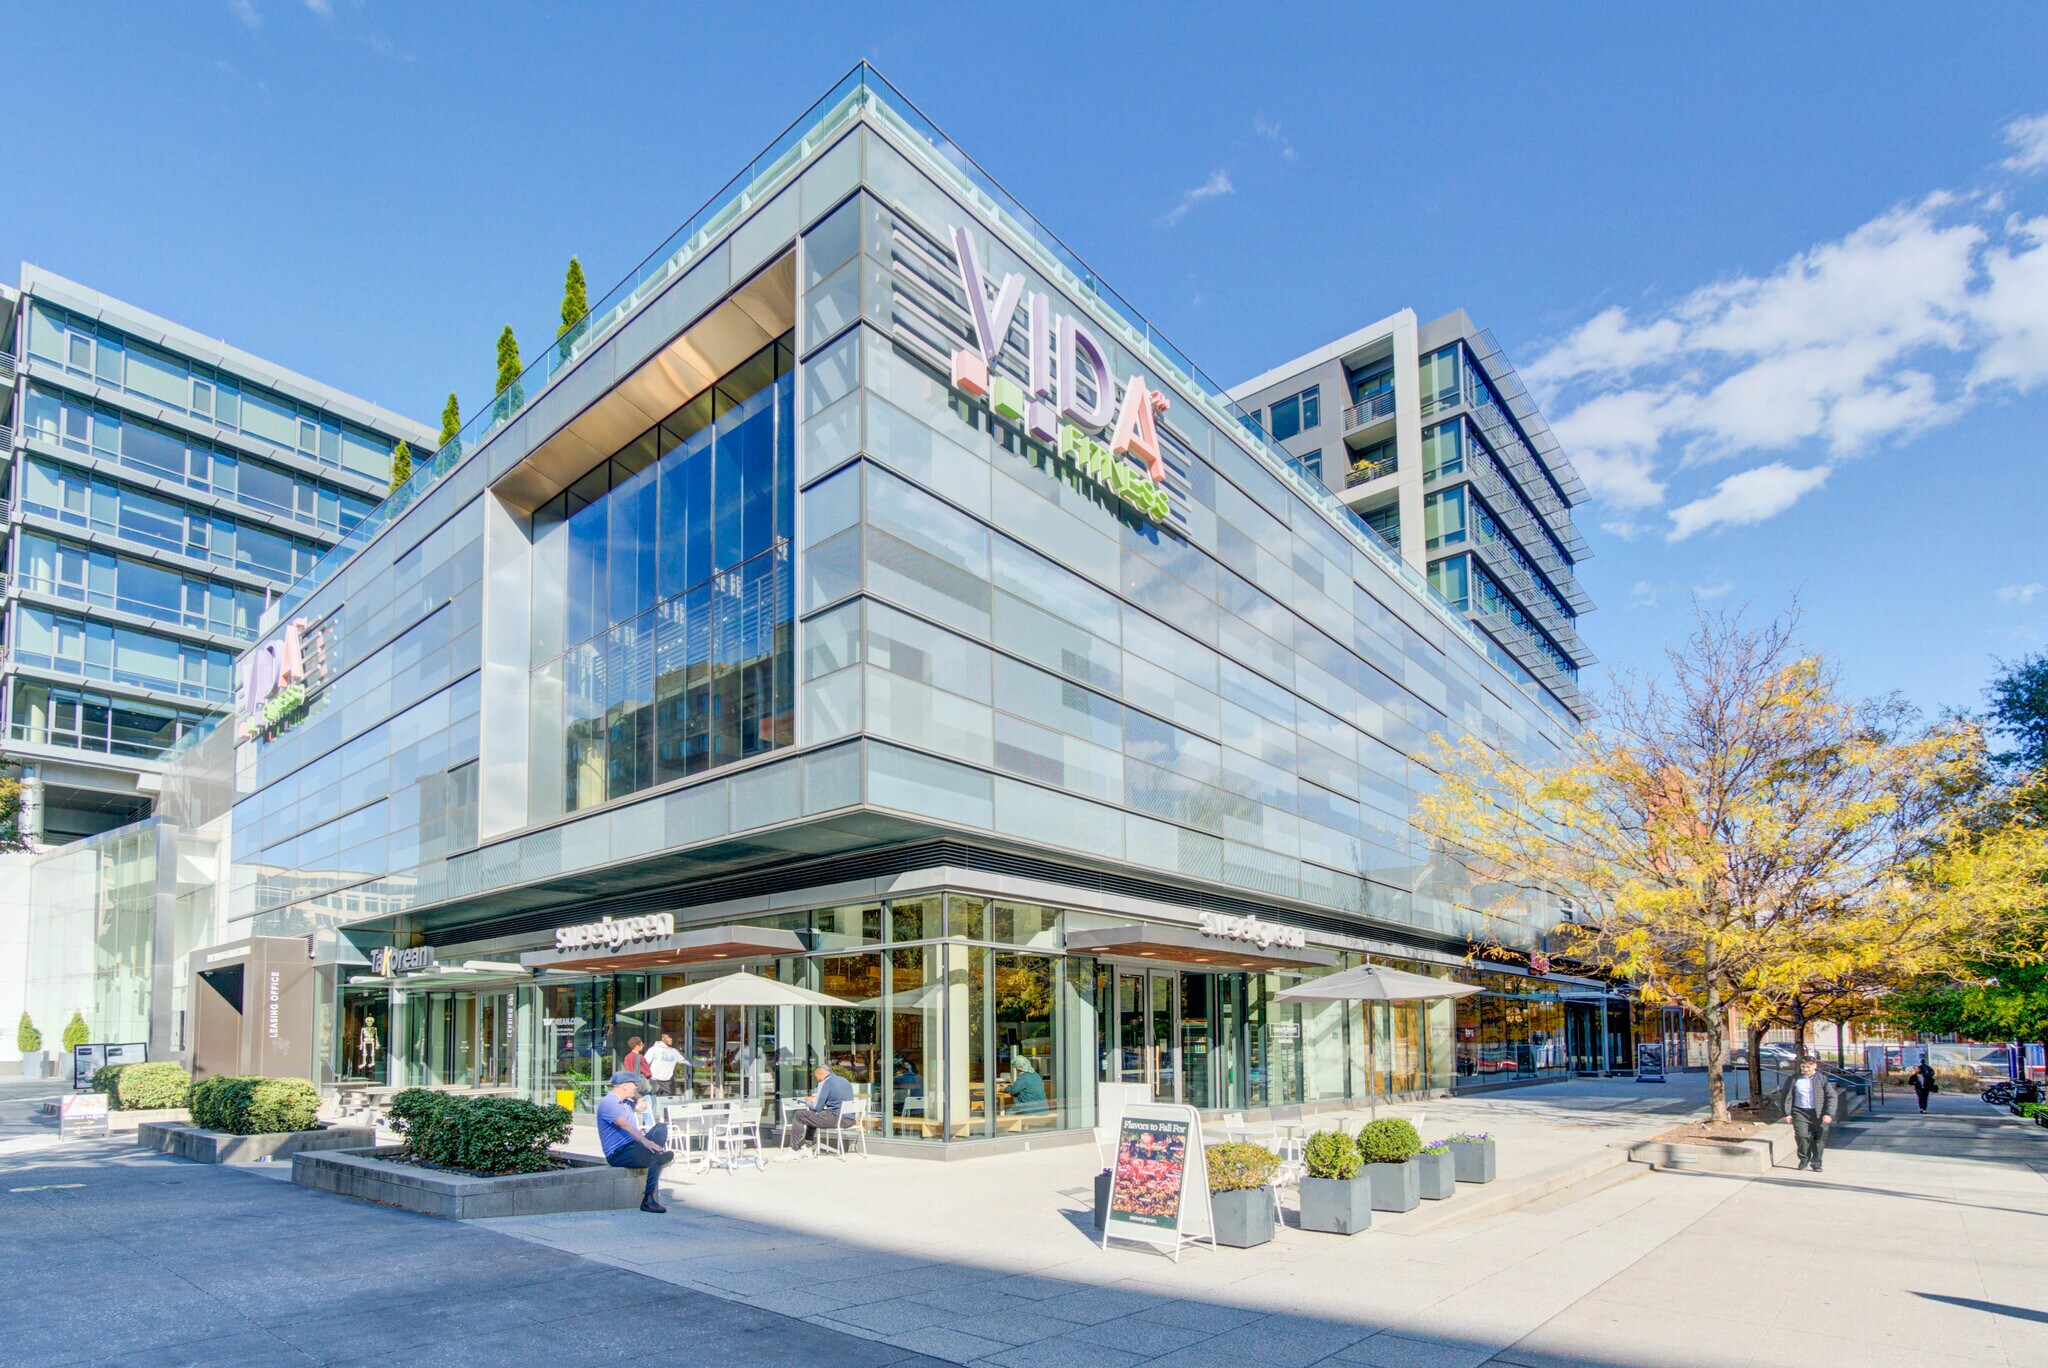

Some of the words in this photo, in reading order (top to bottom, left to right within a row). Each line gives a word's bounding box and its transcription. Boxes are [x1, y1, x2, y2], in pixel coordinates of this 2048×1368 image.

[948, 223, 1166, 482] VIDA
[1058, 423, 1170, 524] FITNESS
[555, 913, 674, 949] sweetgreen
[271, 971, 280, 1001] OFFICE
[269, 1004, 279, 1038] LEASING
[1123, 1120, 1149, 1131] Flavors
[1150, 1123, 1158, 1131] to
[1158, 1123, 1172, 1132] Fall
[1173, 1125, 1187, 1133] For
